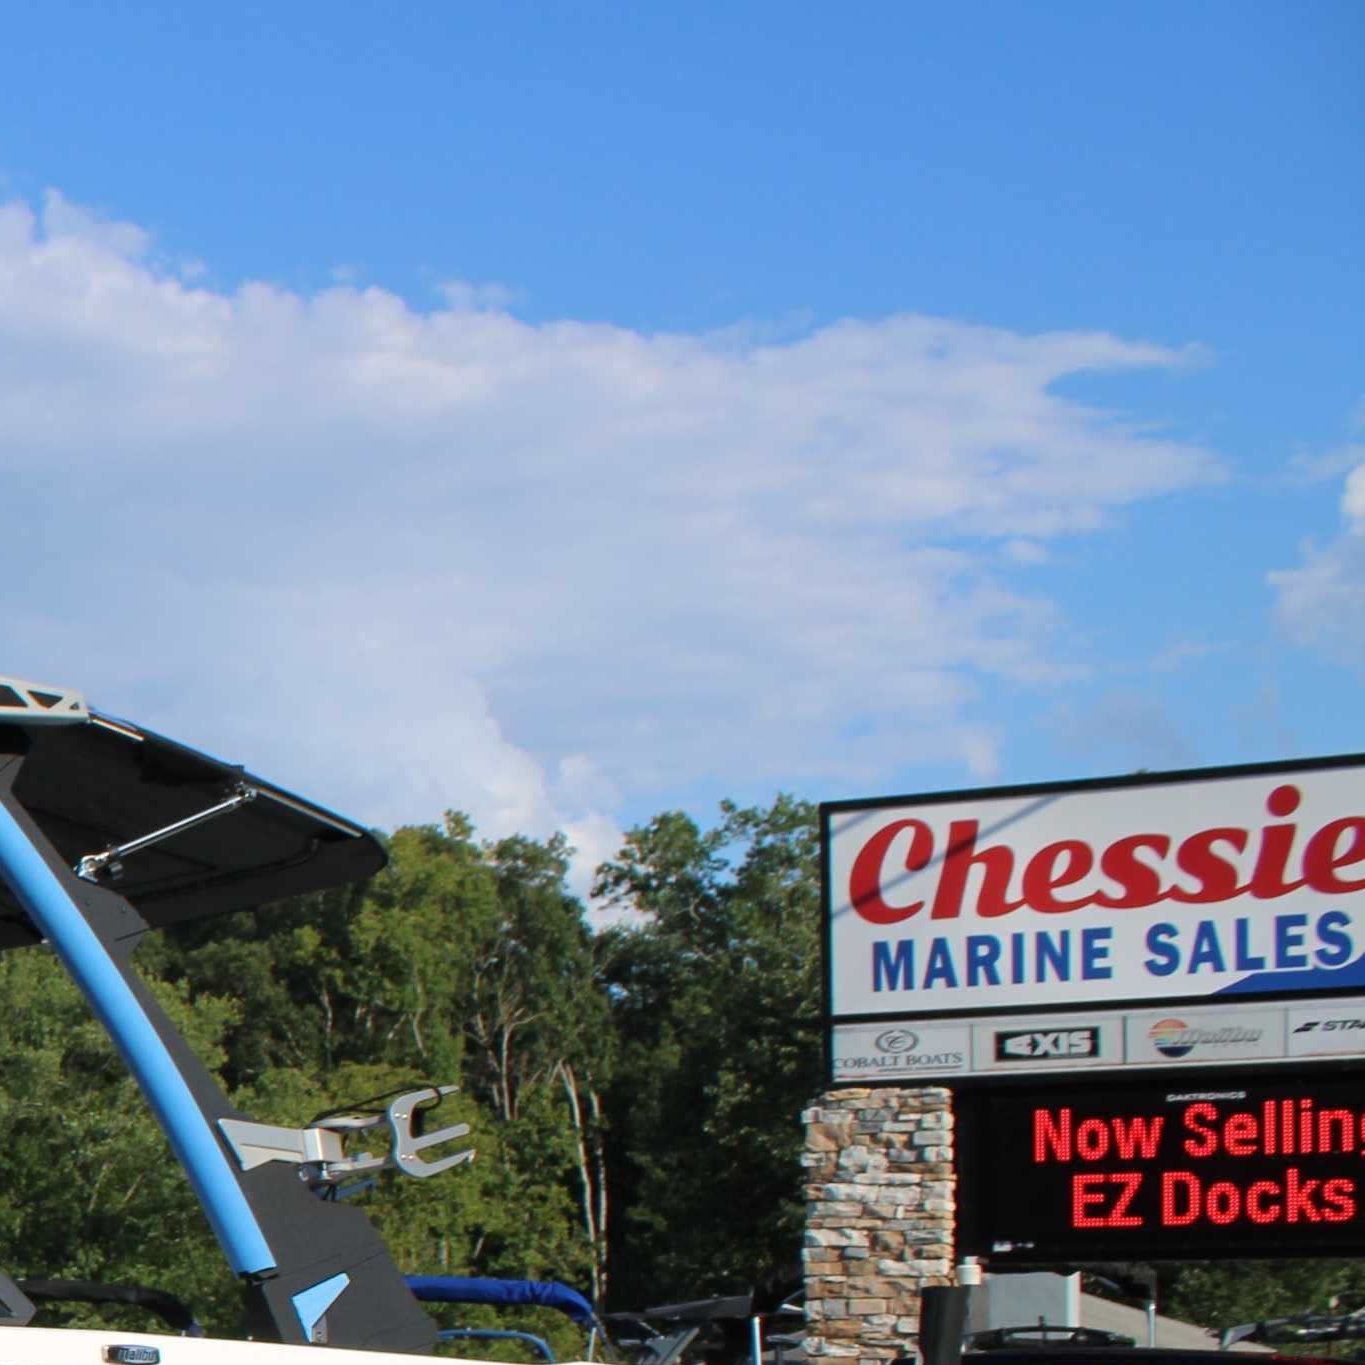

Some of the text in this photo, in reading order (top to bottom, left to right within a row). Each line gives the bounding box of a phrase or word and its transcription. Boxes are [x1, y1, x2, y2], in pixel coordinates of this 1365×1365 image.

[848, 784, 1365, 925] Chessie
[872, 911, 1353, 992] MARINE SALES
[834, 1055, 900, 1069] COBALT
[905, 1053, 963, 1066] BOATS
[1004, 1030, 1093, 1056] AXIS
[1033, 1099, 1365, 1162] Now Sellin
[1072, 1168, 1356, 1227] EZ Docks
